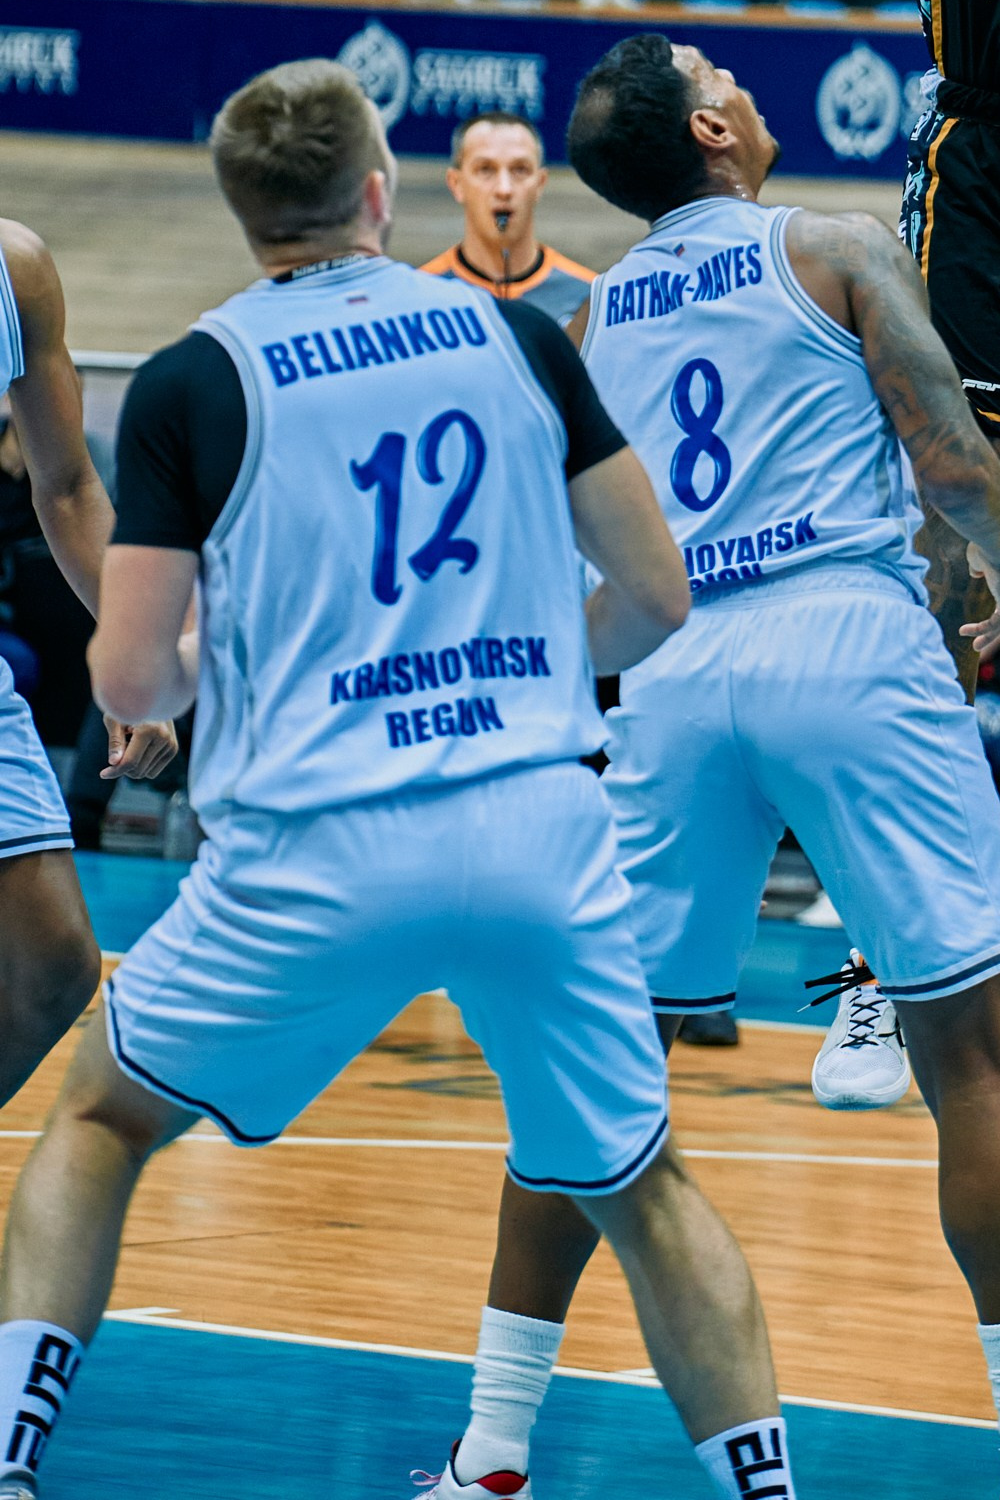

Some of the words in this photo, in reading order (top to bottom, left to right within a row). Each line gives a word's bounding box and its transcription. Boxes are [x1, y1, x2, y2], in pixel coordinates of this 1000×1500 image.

[262, 307, 487, 388] BELIANKOU
[350, 409, 487, 606] 12
[670, 358, 731, 512] 8
